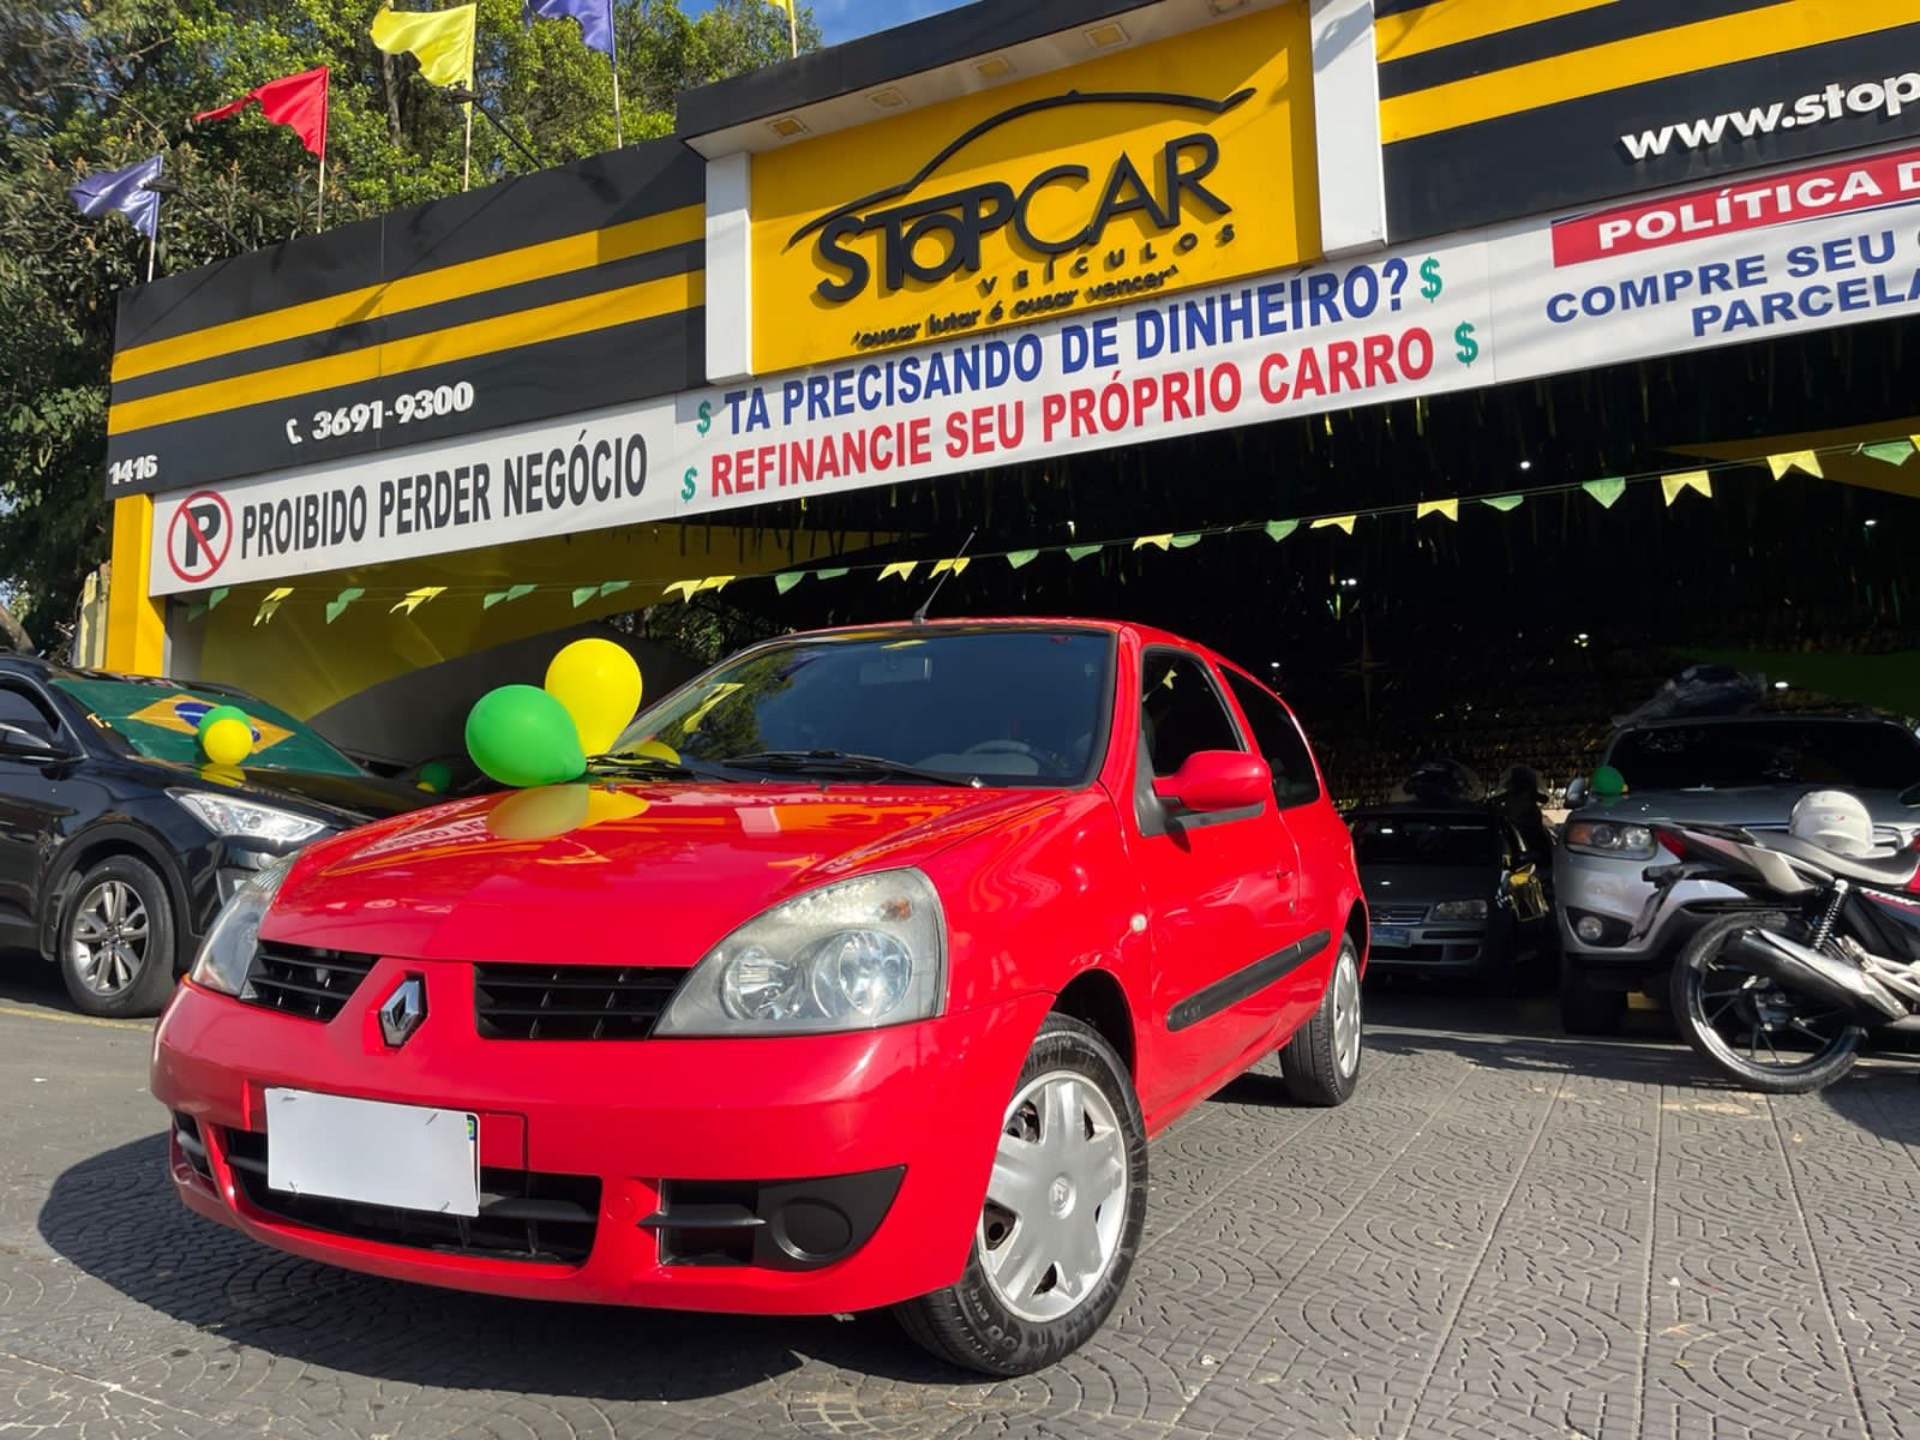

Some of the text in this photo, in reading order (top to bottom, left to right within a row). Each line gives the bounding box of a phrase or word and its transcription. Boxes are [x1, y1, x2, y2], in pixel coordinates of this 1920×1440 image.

[1599, 170, 1883, 250] POLÍTICA
[1546, 230, 1896, 324] COMPRE SEU
[725, 386, 770, 434] TA
[783, 333, 1043, 426] PRECISANDO
[1061, 316, 1120, 375] DE
[1136, 257, 1409, 361] DINHEIRO?
[312, 381, 474, 441] 3691-9300
[711, 418, 932, 498] REFINANCIE
[945, 400, 1025, 459] SEU
[1042, 362, 1242, 443] PRÓPRIO
[1258, 327, 1434, 405] CARRO
[109, 454, 158, 486] 1416
[240, 428, 647, 560] PROIBIDO PERDER NEGÓCIO
